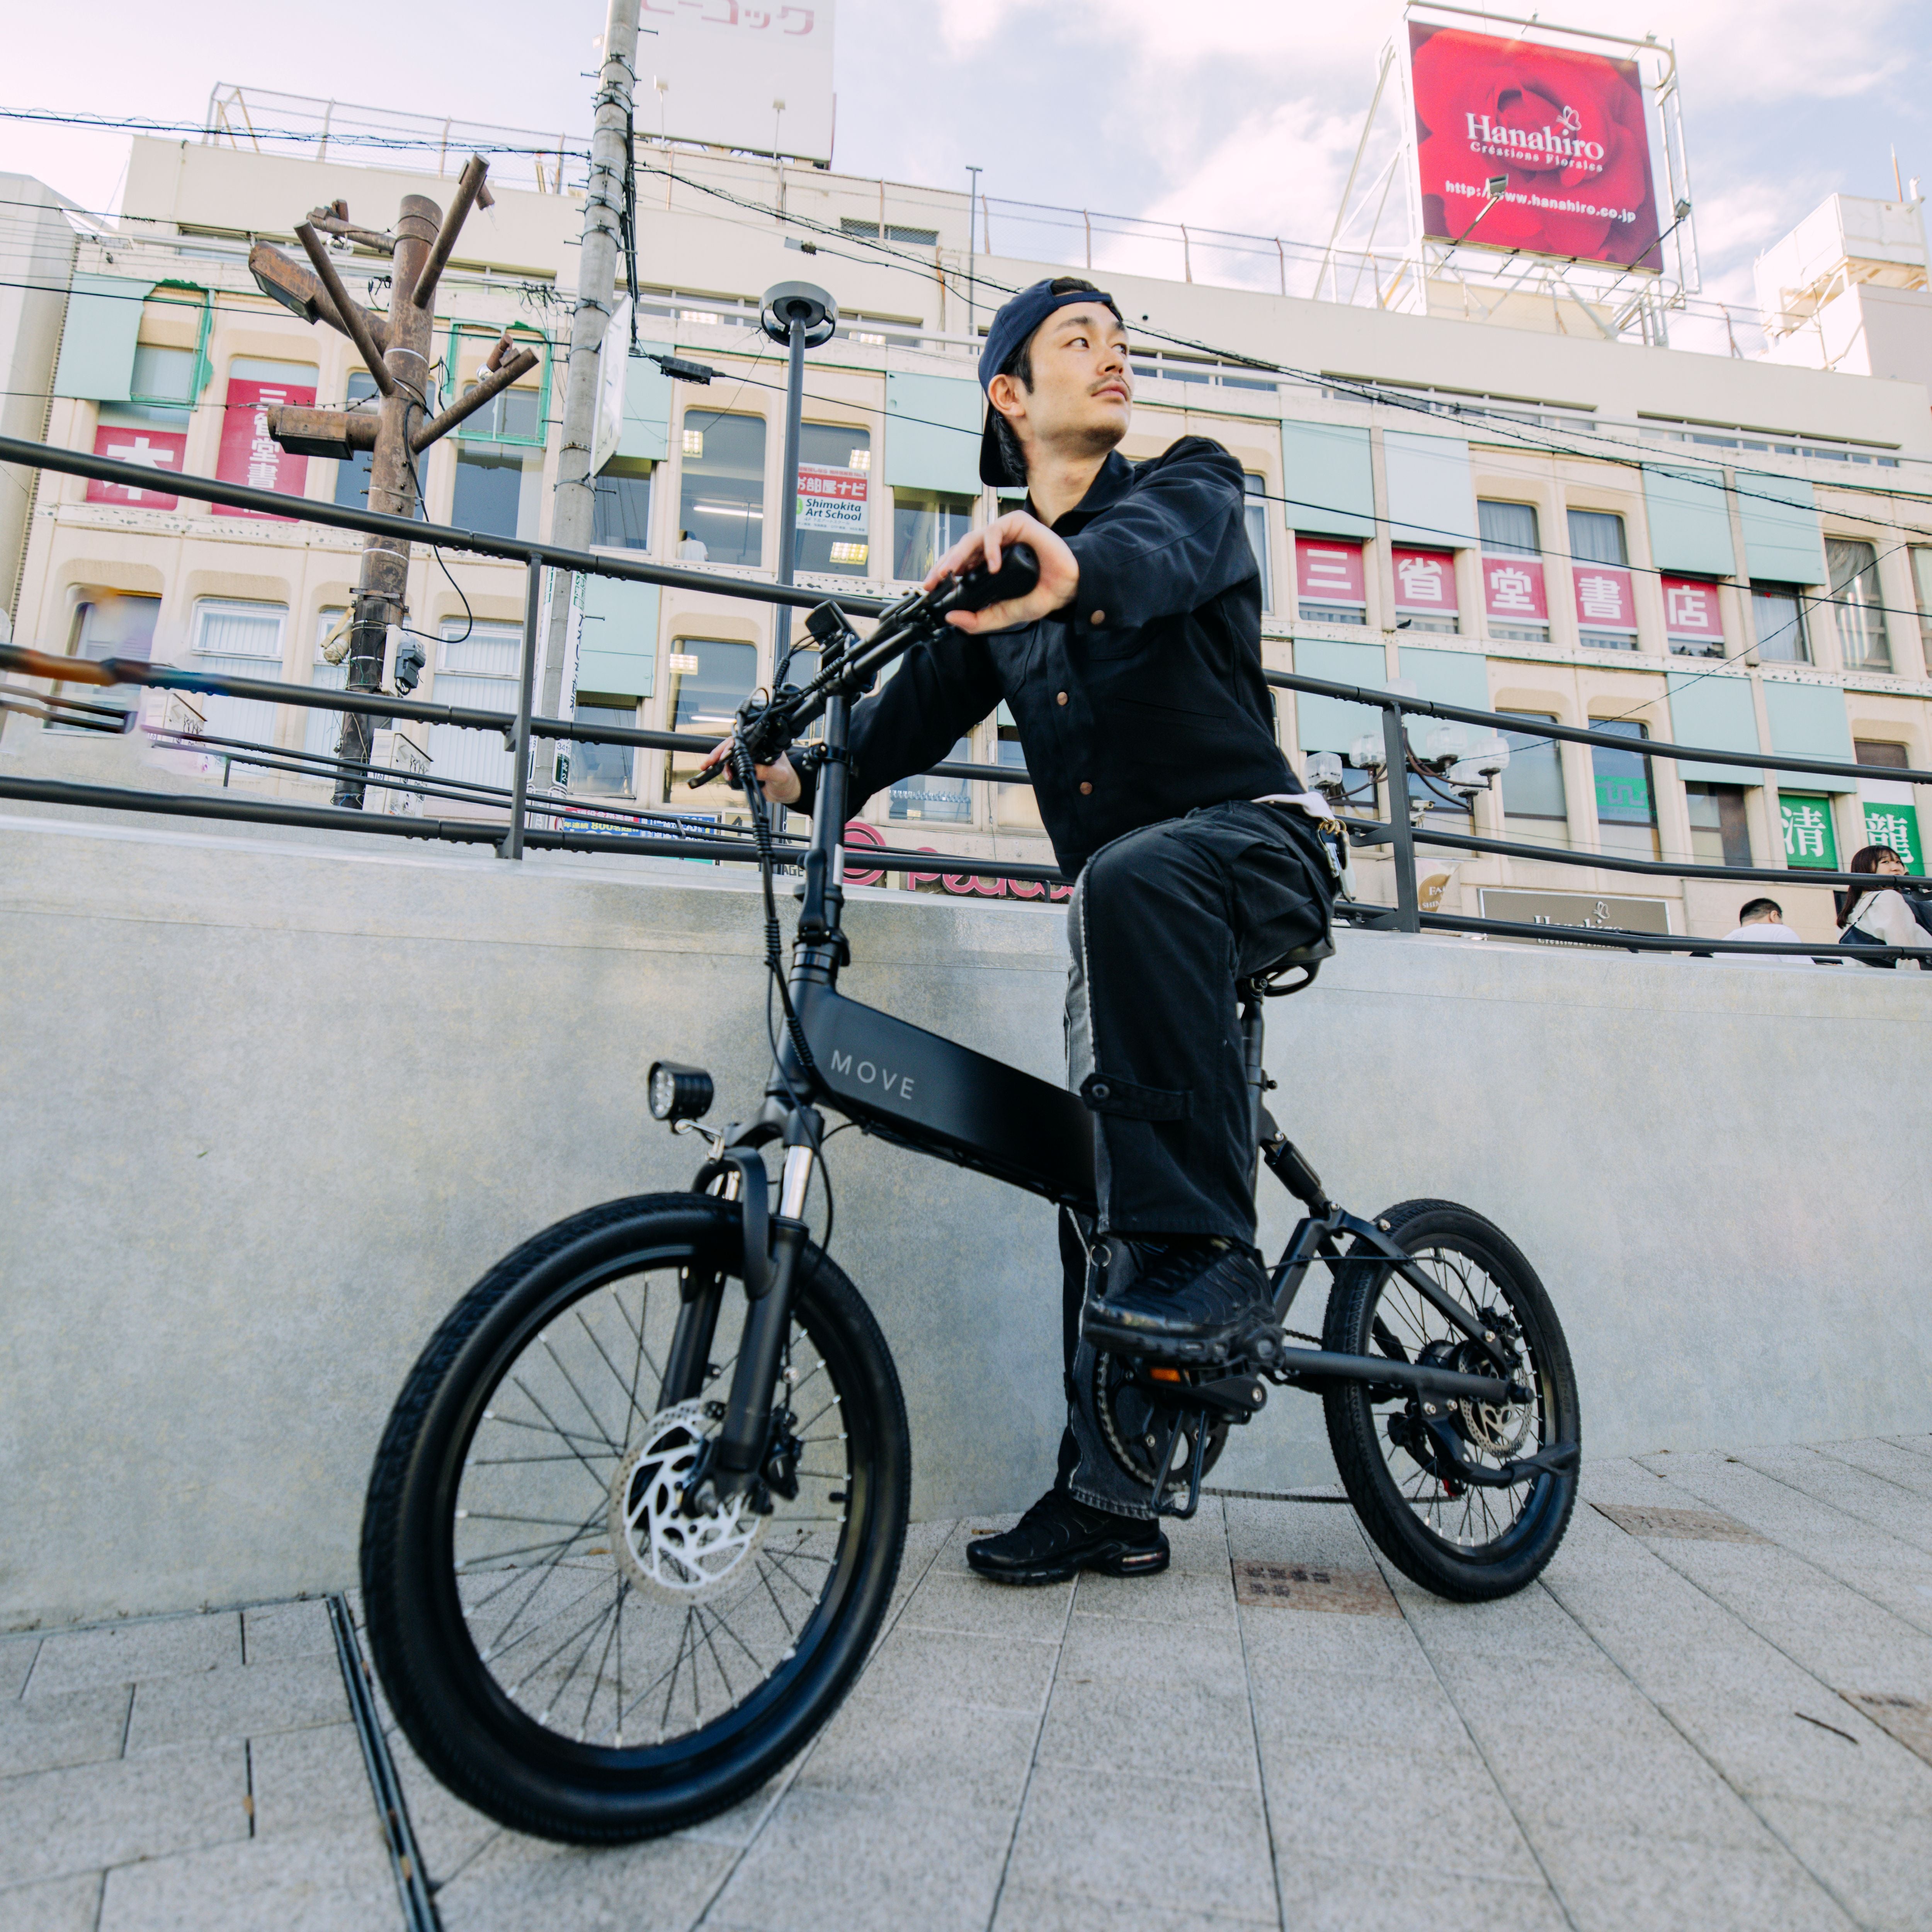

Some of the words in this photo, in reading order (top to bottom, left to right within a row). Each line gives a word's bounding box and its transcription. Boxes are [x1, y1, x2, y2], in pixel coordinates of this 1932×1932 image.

[1466, 112, 1604, 160] Hanahiro
[1470, 141, 1539, 162] Créations
[1546, 154, 1603, 172] Florales
[1446, 180, 1636, 223] http:/ww.hanahiro.co.jp
[102, 437, 174, 500] 本
[243, 388, 287, 514] 三省堂書
[806, 498, 861, 512] Shimokita
[806, 508, 823, 517] Art
[825, 510, 861, 521] School
[831, 1049, 915, 1100] MOVE
